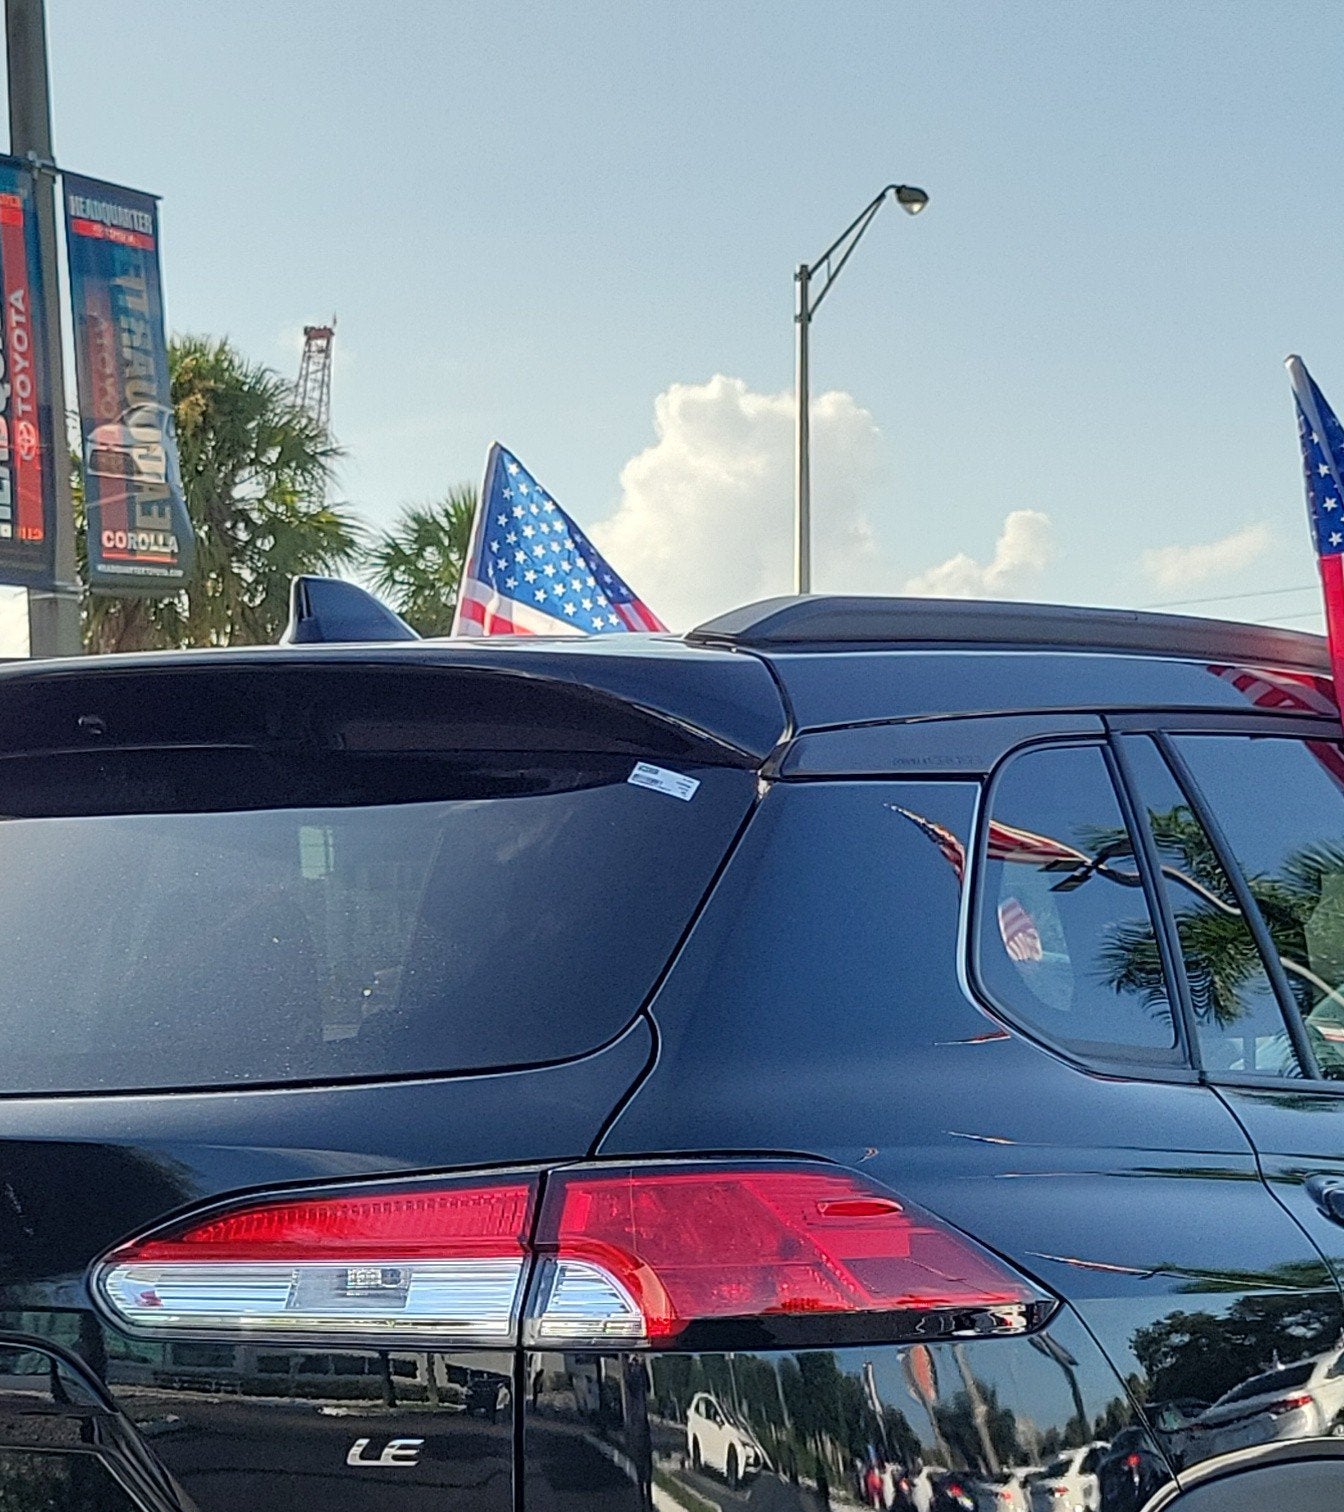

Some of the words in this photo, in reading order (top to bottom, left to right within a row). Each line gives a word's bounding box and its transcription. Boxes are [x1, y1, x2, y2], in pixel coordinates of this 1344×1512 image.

[11, 288, 33, 416] TOYOTA
[101, 530, 179, 554] COROLLA
[346, 1437, 425, 1467] LE
